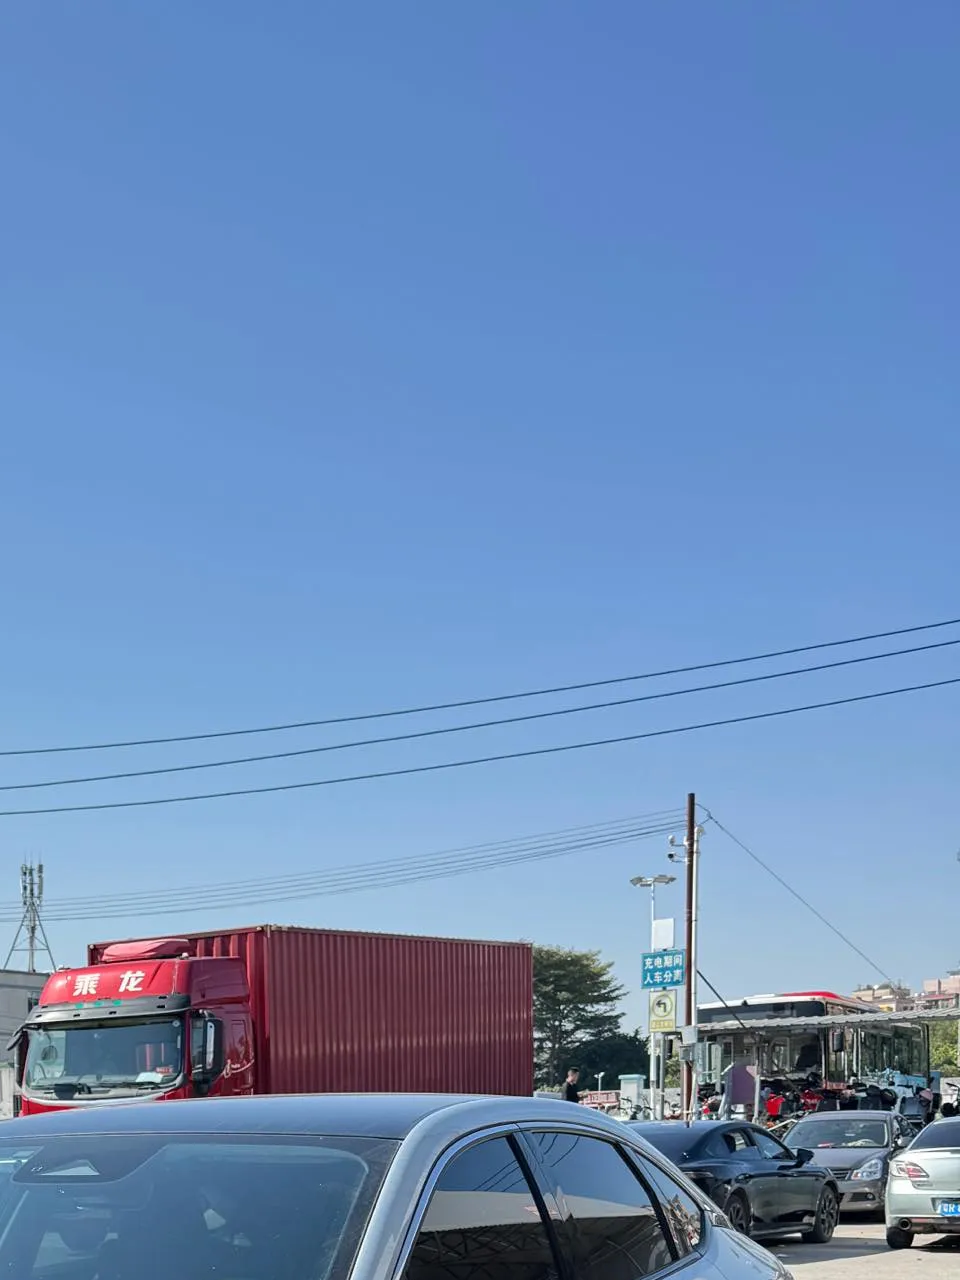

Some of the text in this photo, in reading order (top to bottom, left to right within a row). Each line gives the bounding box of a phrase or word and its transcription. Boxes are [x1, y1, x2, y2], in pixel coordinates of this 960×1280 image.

[644, 954, 683, 970] 充电期间
[72, 970, 146, 997] 乘龙
[644, 968, 683, 984] 人车分离
